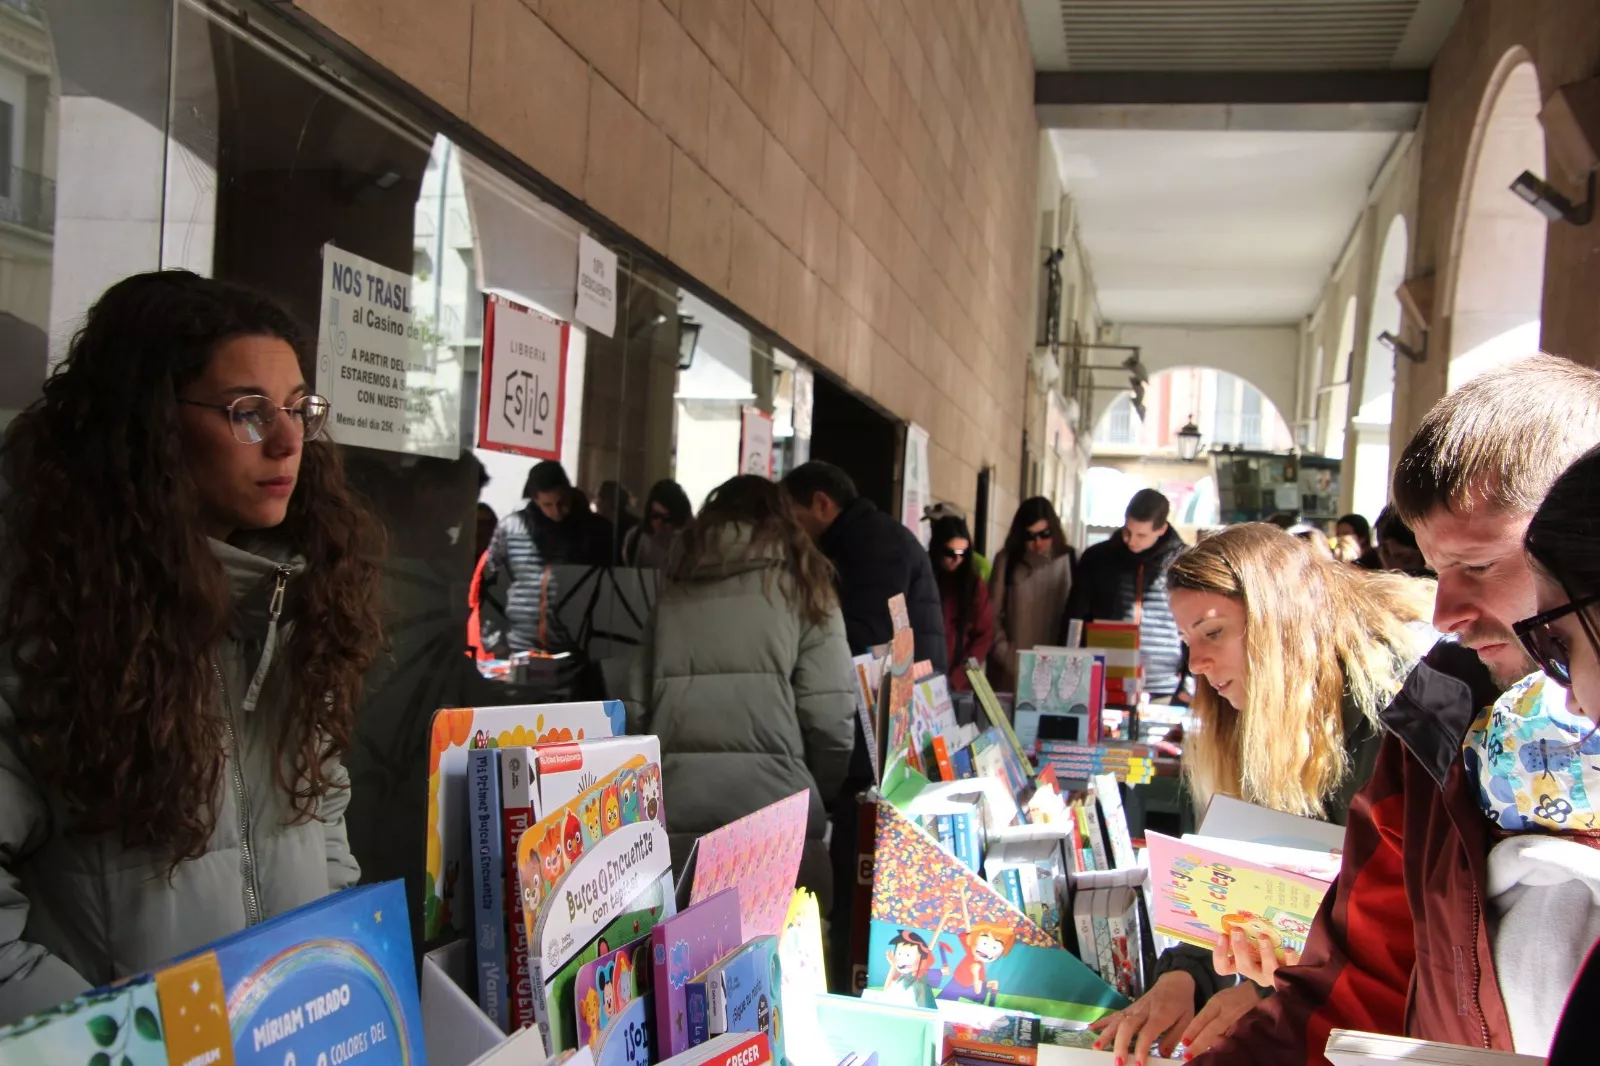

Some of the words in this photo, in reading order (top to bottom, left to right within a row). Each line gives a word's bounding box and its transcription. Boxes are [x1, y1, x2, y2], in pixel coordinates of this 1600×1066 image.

[332, 261, 362, 298] NOS
[366, 273, 412, 314] TRASL
[352, 306, 363, 325] al
[366, 308, 404, 337] Casino
[351, 348, 357, 361] A
[360, 349, 388, 370] PARTIR
[390, 355, 405, 373] DEL
[510, 340, 546, 363] LIBRERIA
[340, 365, 390, 388] ESTAREMOS
[392, 377, 398, 389] A
[357, 389, 375, 406] CON
[357, 416, 368, 429] del
[477, 775, 492, 812] Primer
[476, 814, 491, 846] Busca
[566, 880, 599, 924] Busca
[607, 832, 653, 888] Encuentra
[1200, 862, 1236, 901] colegio
[592, 901, 609, 924] con
[1201, 899, 1227, 912] el
[1184, 920, 1214, 933] A
[252, 1006, 304, 1053] MÍRIAM
[304, 984, 351, 1024] TIRADO
[330, 1031, 369, 1066] COLORES
[370, 1021, 388, 1045] DEL
